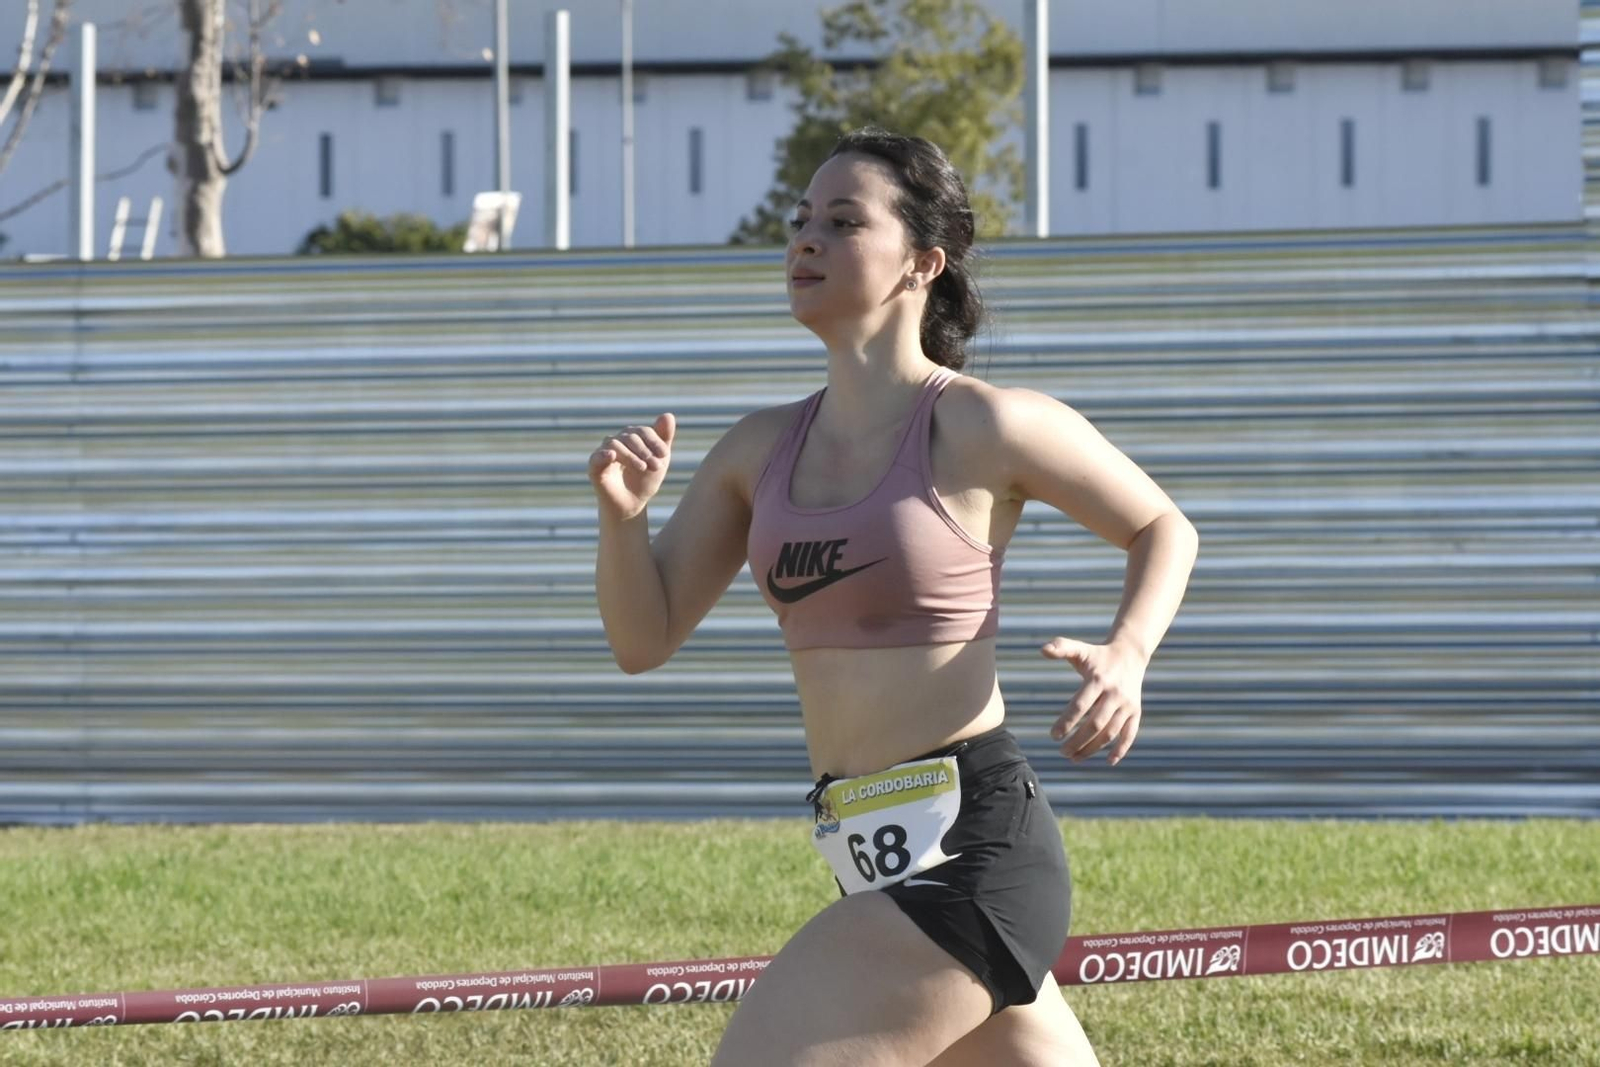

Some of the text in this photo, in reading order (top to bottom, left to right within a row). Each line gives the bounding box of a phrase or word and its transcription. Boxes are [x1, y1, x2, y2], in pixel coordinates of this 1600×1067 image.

[775, 538, 848, 579] NIKE
[842, 770, 949, 804] LA CORDOBARIA
[847, 824, 911, 883] 68
[1326, 922, 1361, 933] Deportes
[1362, 921, 1373, 930] de
[1374, 919, 1412, 930] Municipal
[1414, 917, 1446, 927] Instituto
[1119, 935, 1156, 946] Deportes
[1156, 934, 1168, 943] de
[1168, 932, 1208, 943] Municipal
[1210, 930, 1243, 940] Instituto
[1287, 934, 1409, 971] IMDECO
[686, 963, 725, 975] Deportes
[726, 962, 738, 972] de
[1079, 948, 1204, 983] IMDECO
[499, 976, 511, 985] de
[513, 973, 556, 985] Municipal
[558, 971, 594, 981] Instituto
[457, 976, 497, 988] Deportes
[262, 990, 274, 999] de
[276, 987, 321, 999] Municipal
[323, 984, 361, 995] Instituto
[218, 990, 260, 1001] Deportes
[14, 1002, 28, 1012] de
[30, 1000, 76, 1012] Municipal
[78, 998, 118, 1008] Instituto
